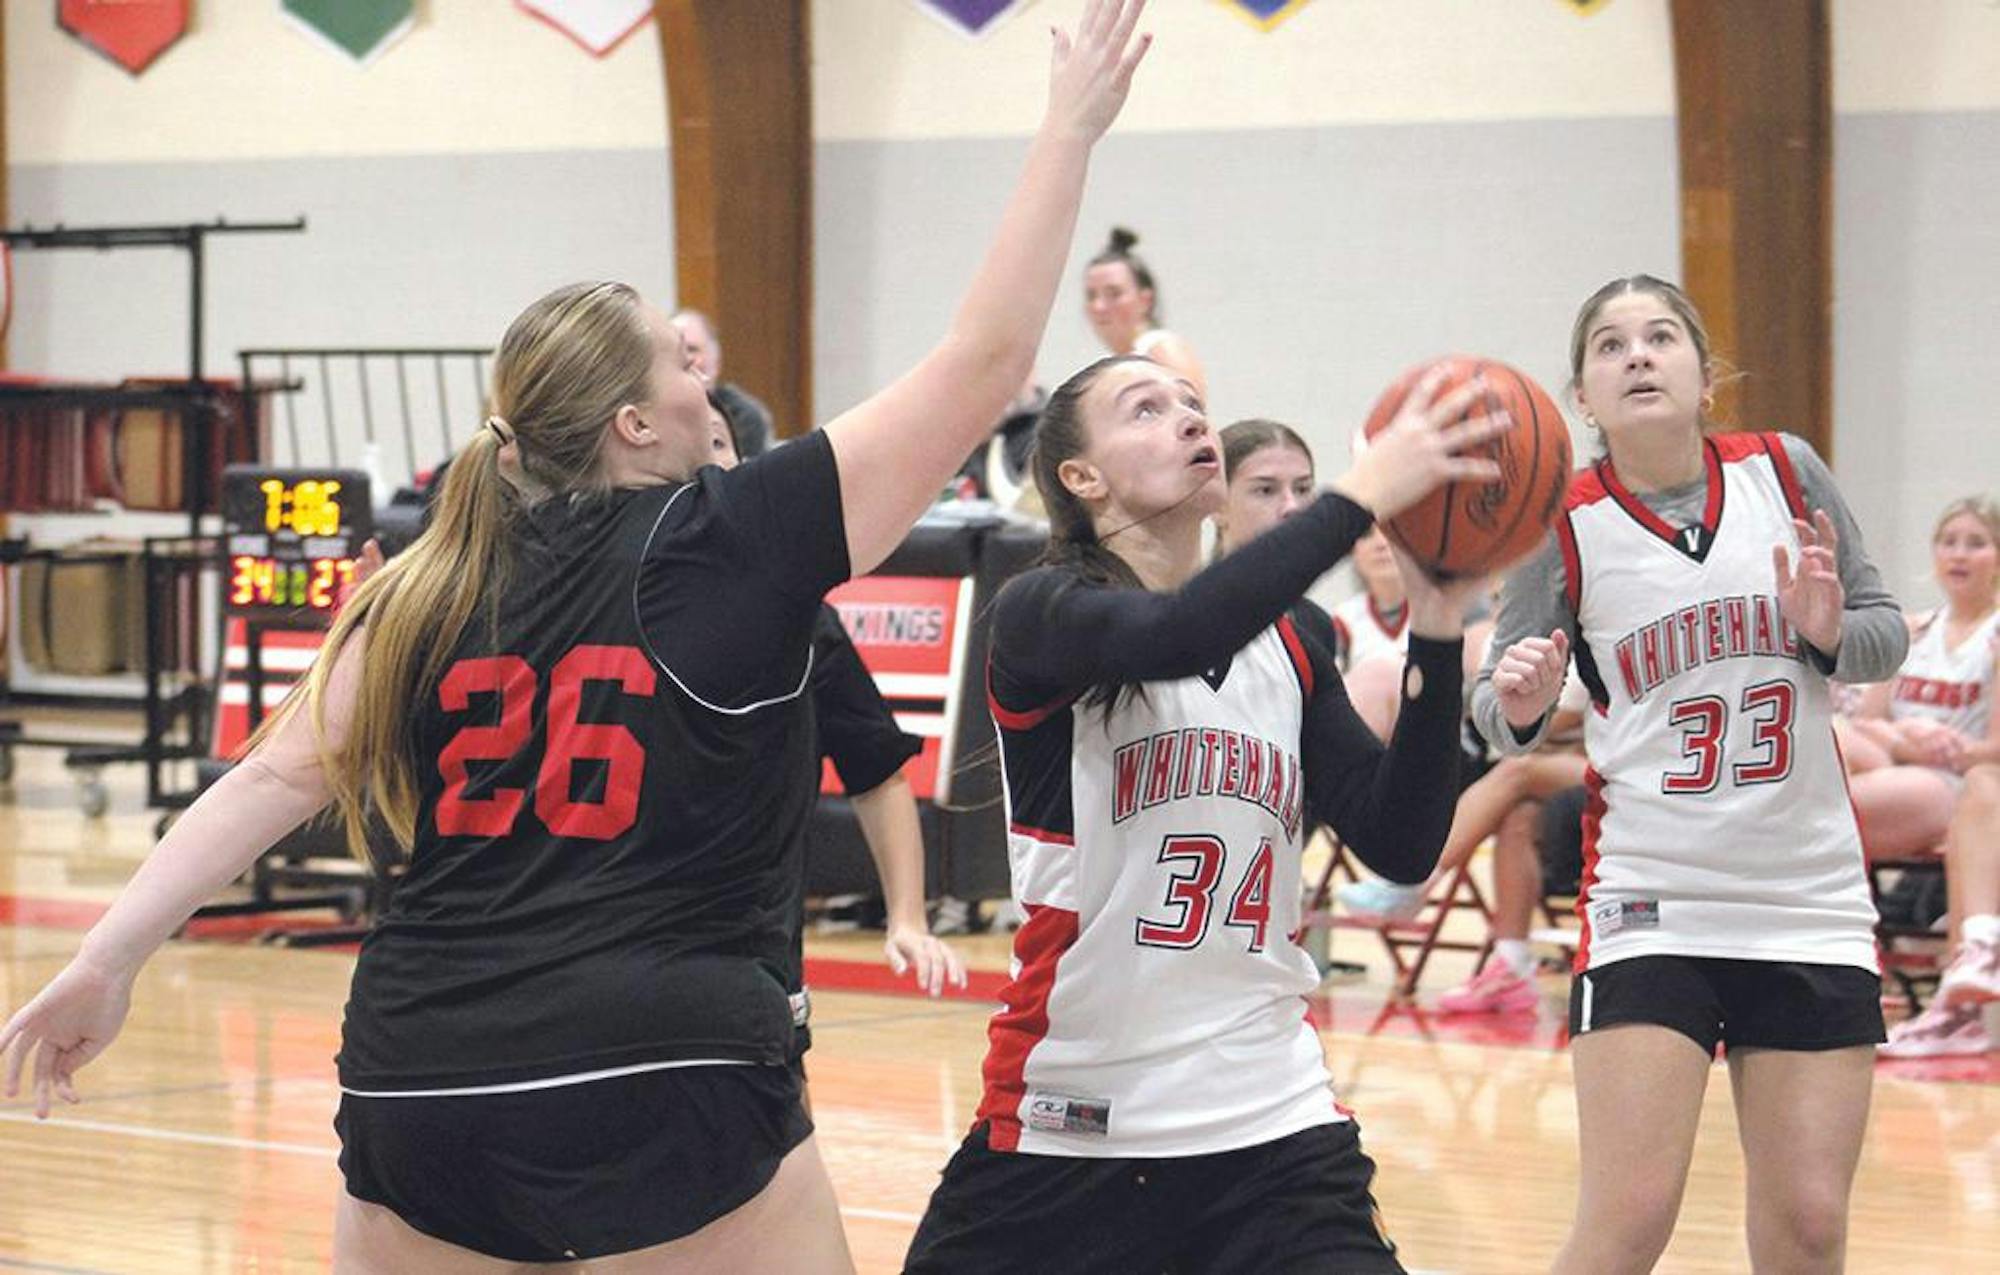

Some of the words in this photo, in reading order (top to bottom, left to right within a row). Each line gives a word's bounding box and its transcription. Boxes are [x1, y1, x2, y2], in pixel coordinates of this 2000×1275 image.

[1613, 594, 1807, 704] WHITEHAL
[435, 643, 657, 841] 26
[1112, 727, 1303, 845] WHITEHAL
[1662, 678, 1796, 795] 33
[1135, 833, 1274, 953] 34
